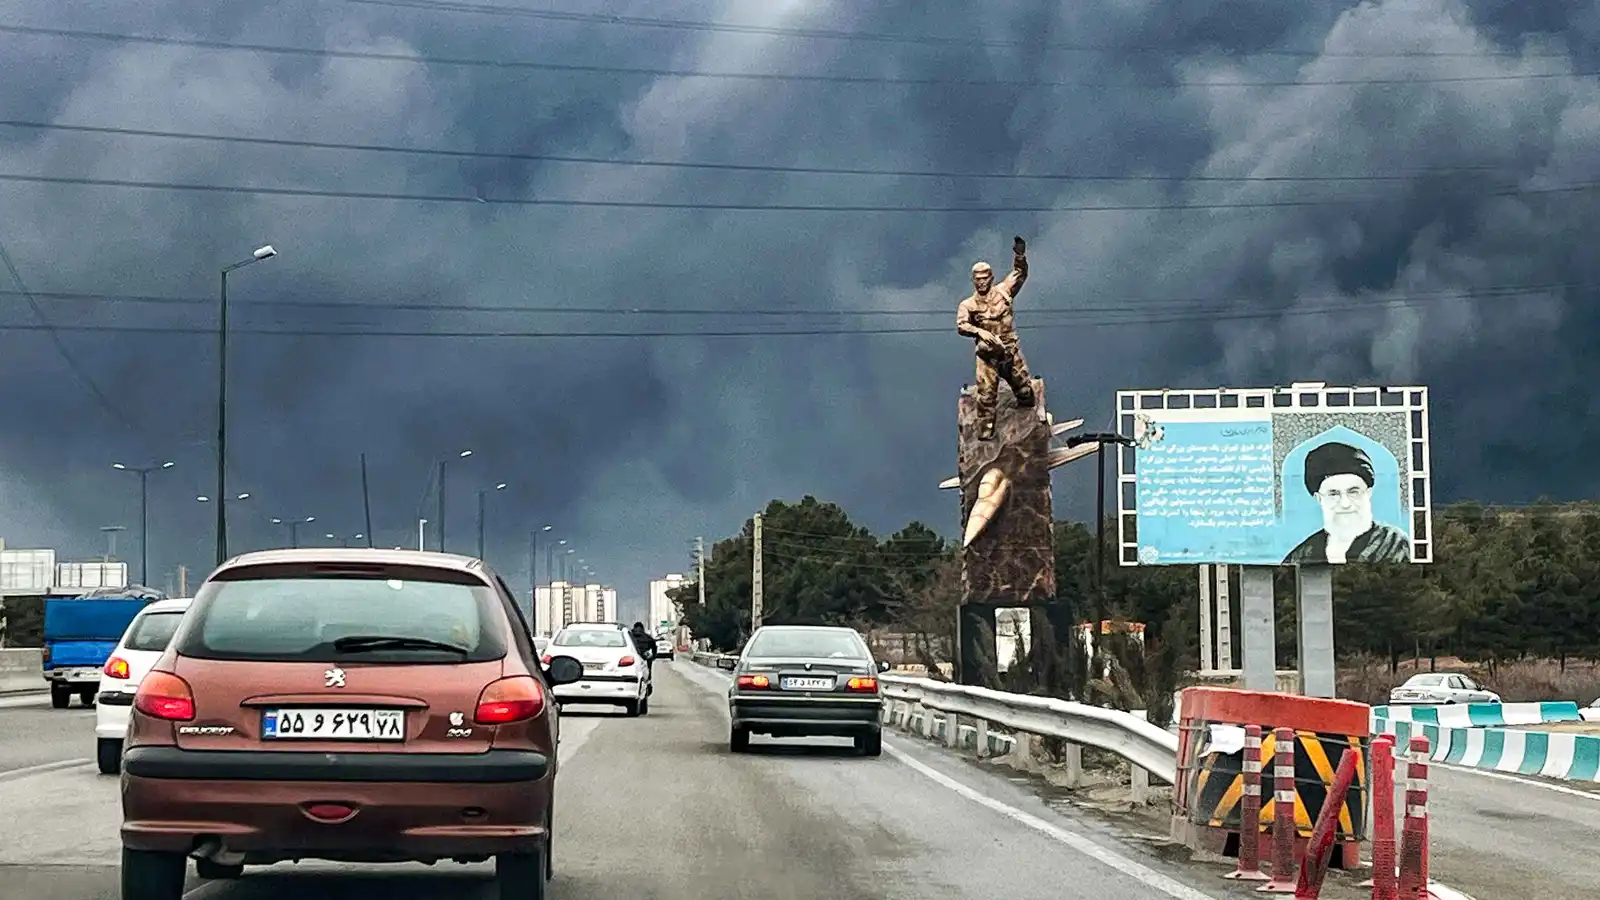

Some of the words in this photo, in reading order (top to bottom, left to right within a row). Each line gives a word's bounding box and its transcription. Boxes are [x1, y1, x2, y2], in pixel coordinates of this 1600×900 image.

[280, 713, 304, 733] ۵۵
[332, 713, 371, 734] ۶۲۹
[376, 718, 400, 736] ۷۸
